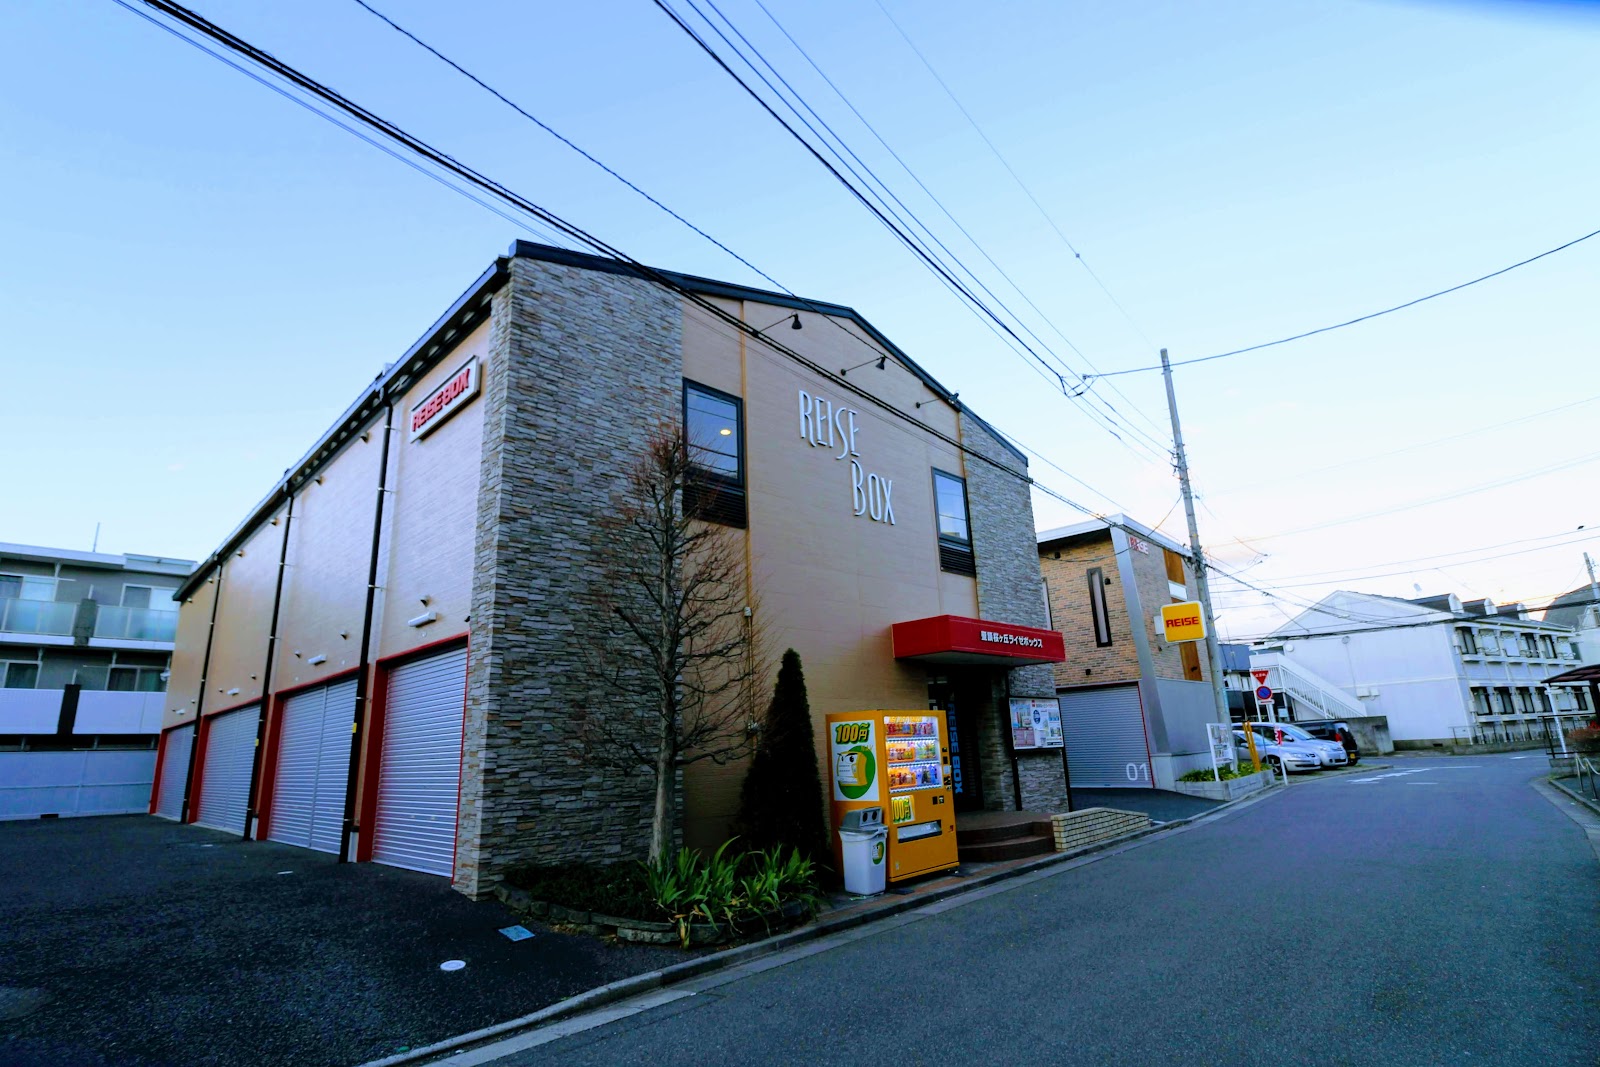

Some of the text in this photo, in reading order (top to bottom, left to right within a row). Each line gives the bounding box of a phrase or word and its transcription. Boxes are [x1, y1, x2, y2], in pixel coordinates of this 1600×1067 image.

[799, 390, 860, 460] REISE
[851, 458, 895, 525] BOX
[1166, 616, 1199, 628] REISE
[948, 703, 963, 794] REISE BOX
[1126, 763, 1148, 781] 01
